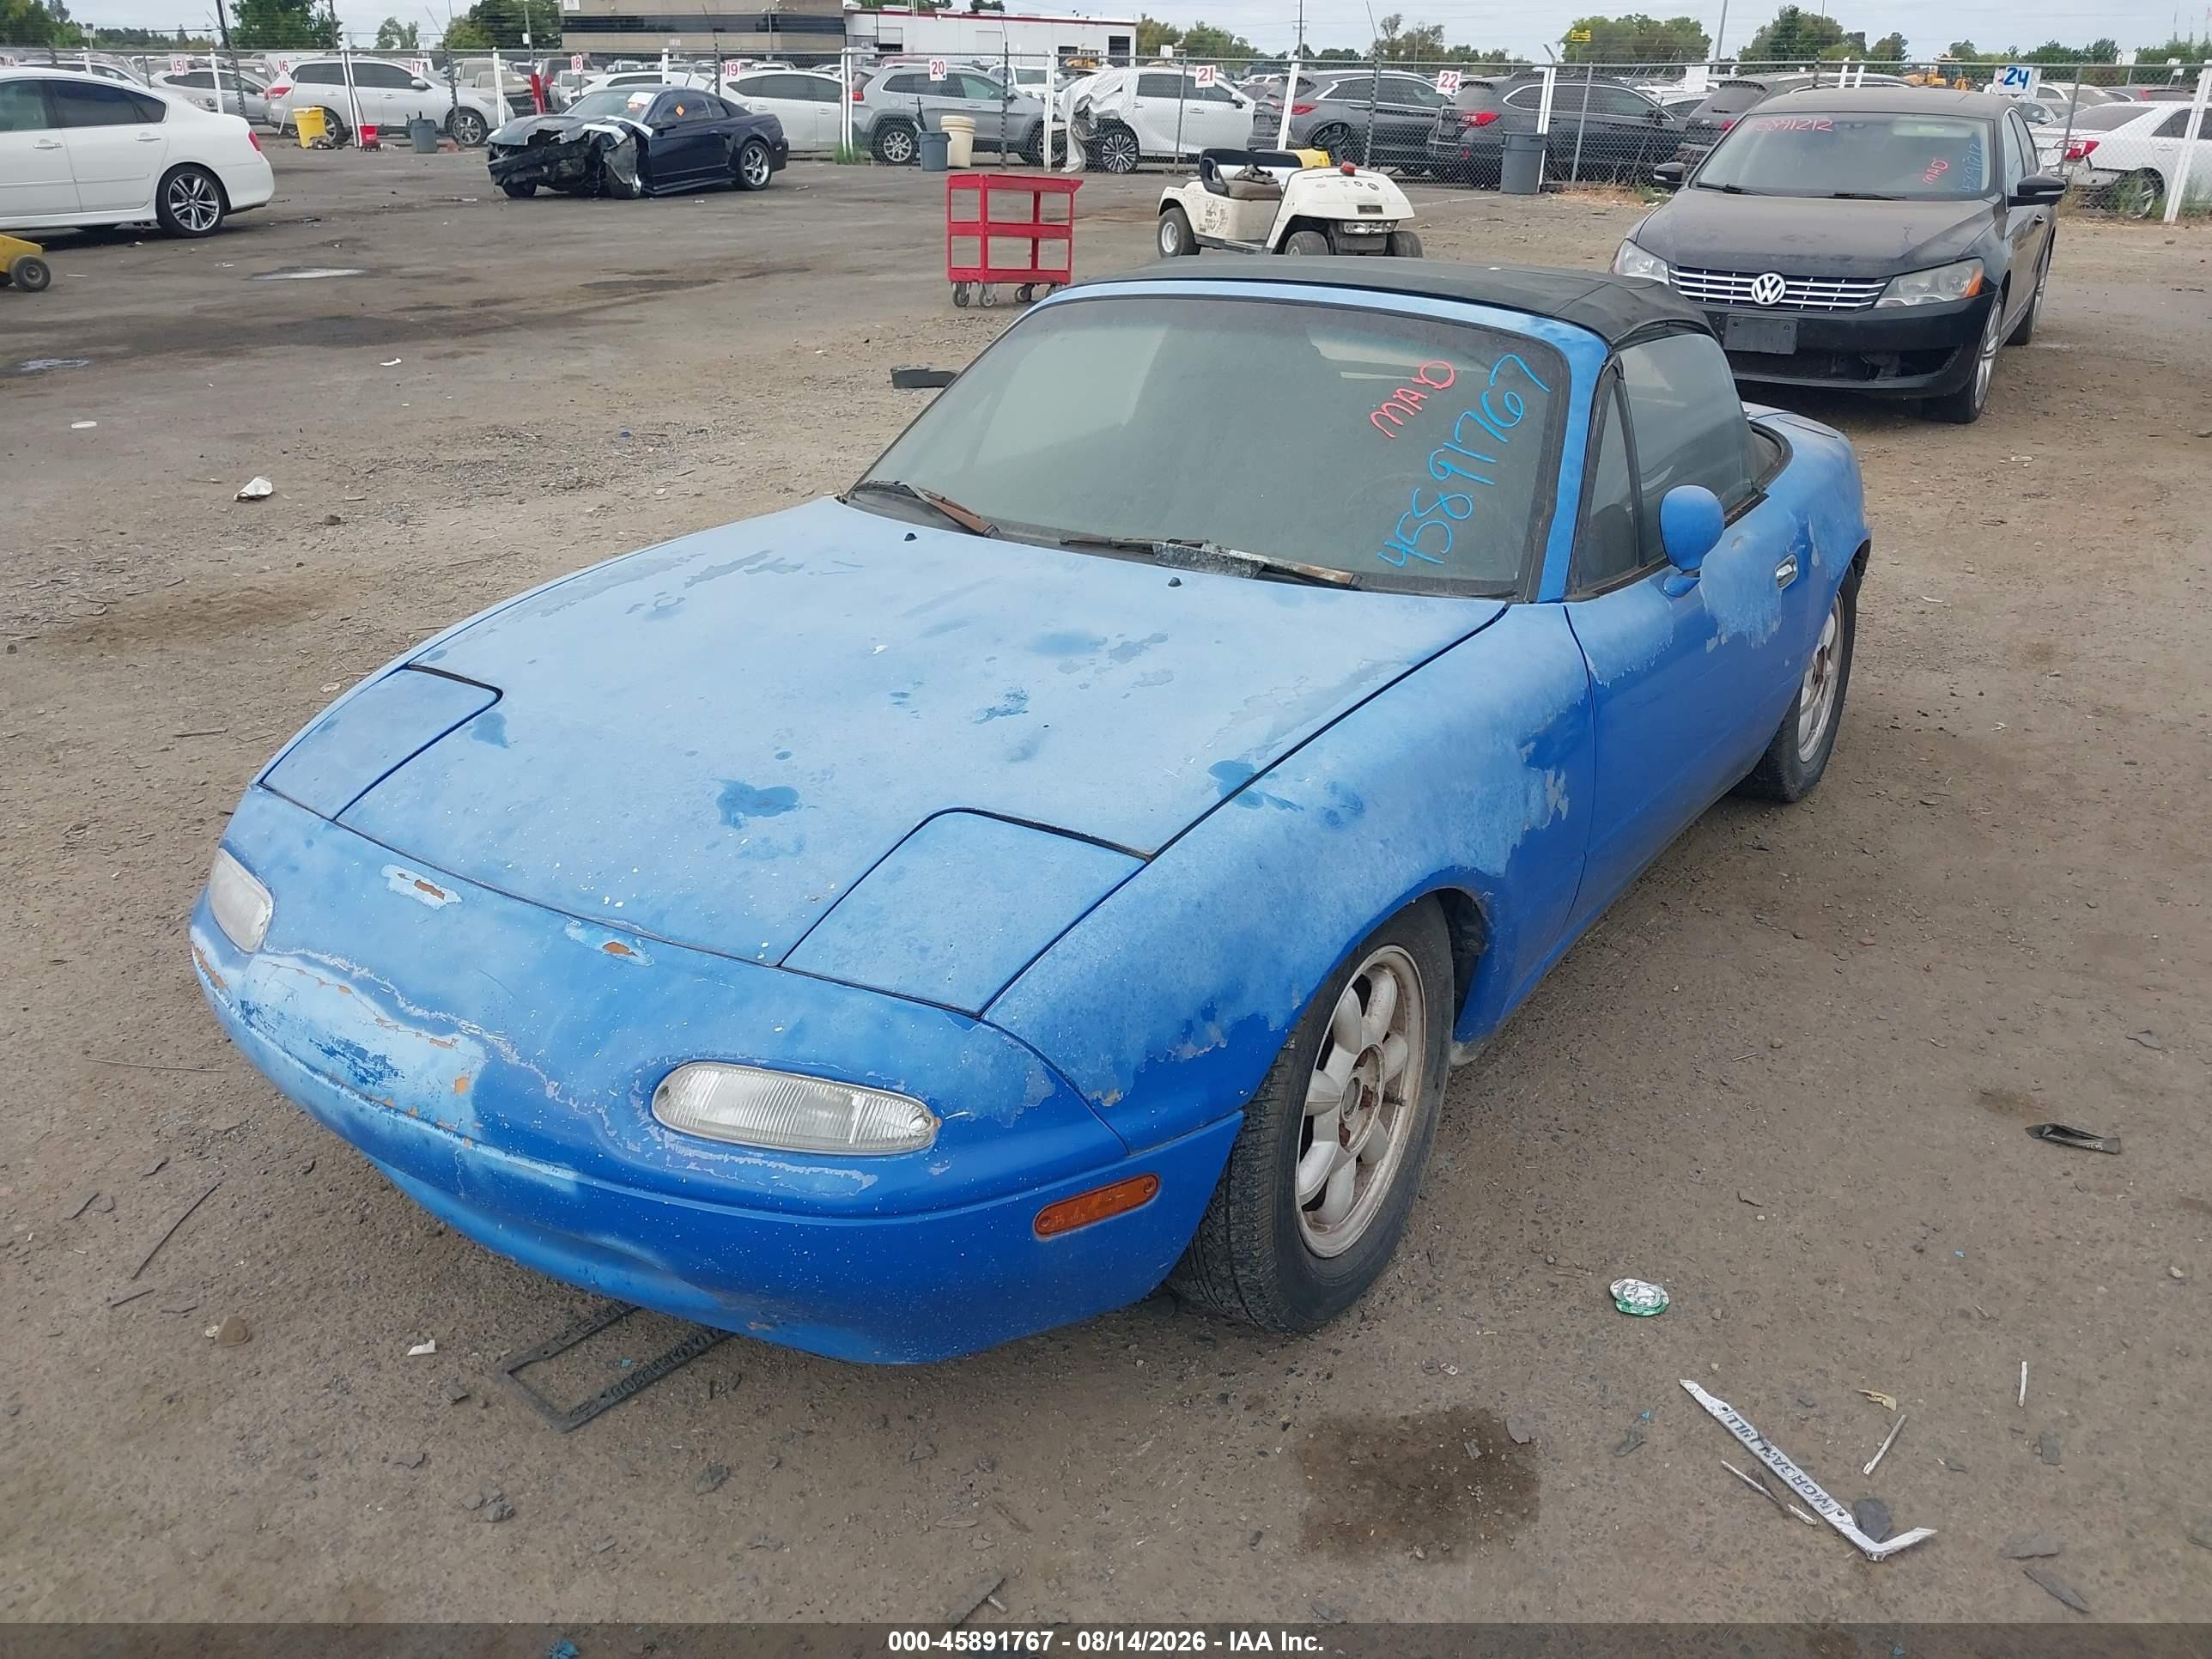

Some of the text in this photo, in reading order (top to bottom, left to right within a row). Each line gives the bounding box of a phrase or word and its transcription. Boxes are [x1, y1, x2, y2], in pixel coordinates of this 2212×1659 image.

[173, 60, 183, 71] 15
[279, 60, 289, 72] 16
[412, 61, 421, 72] 17
[573, 57, 580, 70] 18
[726, 63, 738, 76] 19
[932, 61, 945, 75] 20
[1198, 67, 1213, 82] 21
[1439, 72, 1458, 88] 22
[2004, 67, 2029, 89] 24
[1377, 354, 1551, 568] 45891767
[1726, 1414, 1833, 1510] MORGAN HILL
